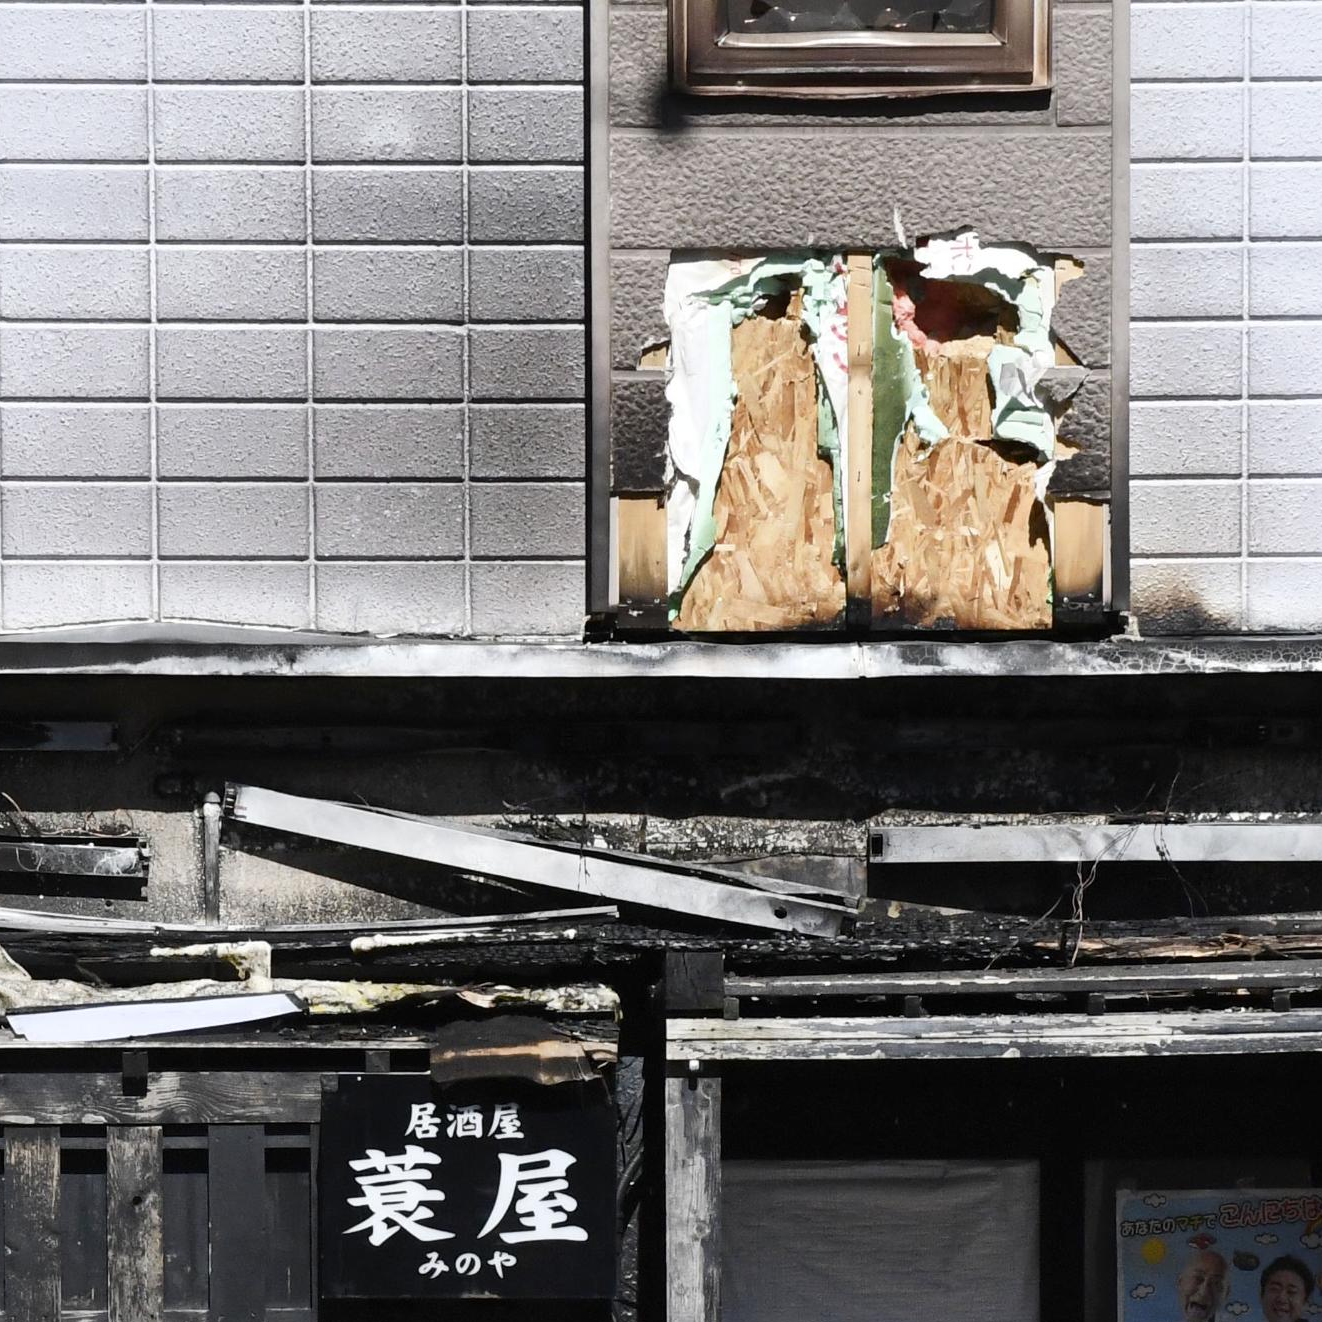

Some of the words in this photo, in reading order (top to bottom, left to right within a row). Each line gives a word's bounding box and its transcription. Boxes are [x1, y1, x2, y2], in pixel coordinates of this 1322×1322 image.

[404, 1102, 525, 1140] 居酒屋
[342, 1144, 589, 1246] 蓑屋
[418, 1252, 517, 1279] みのや
